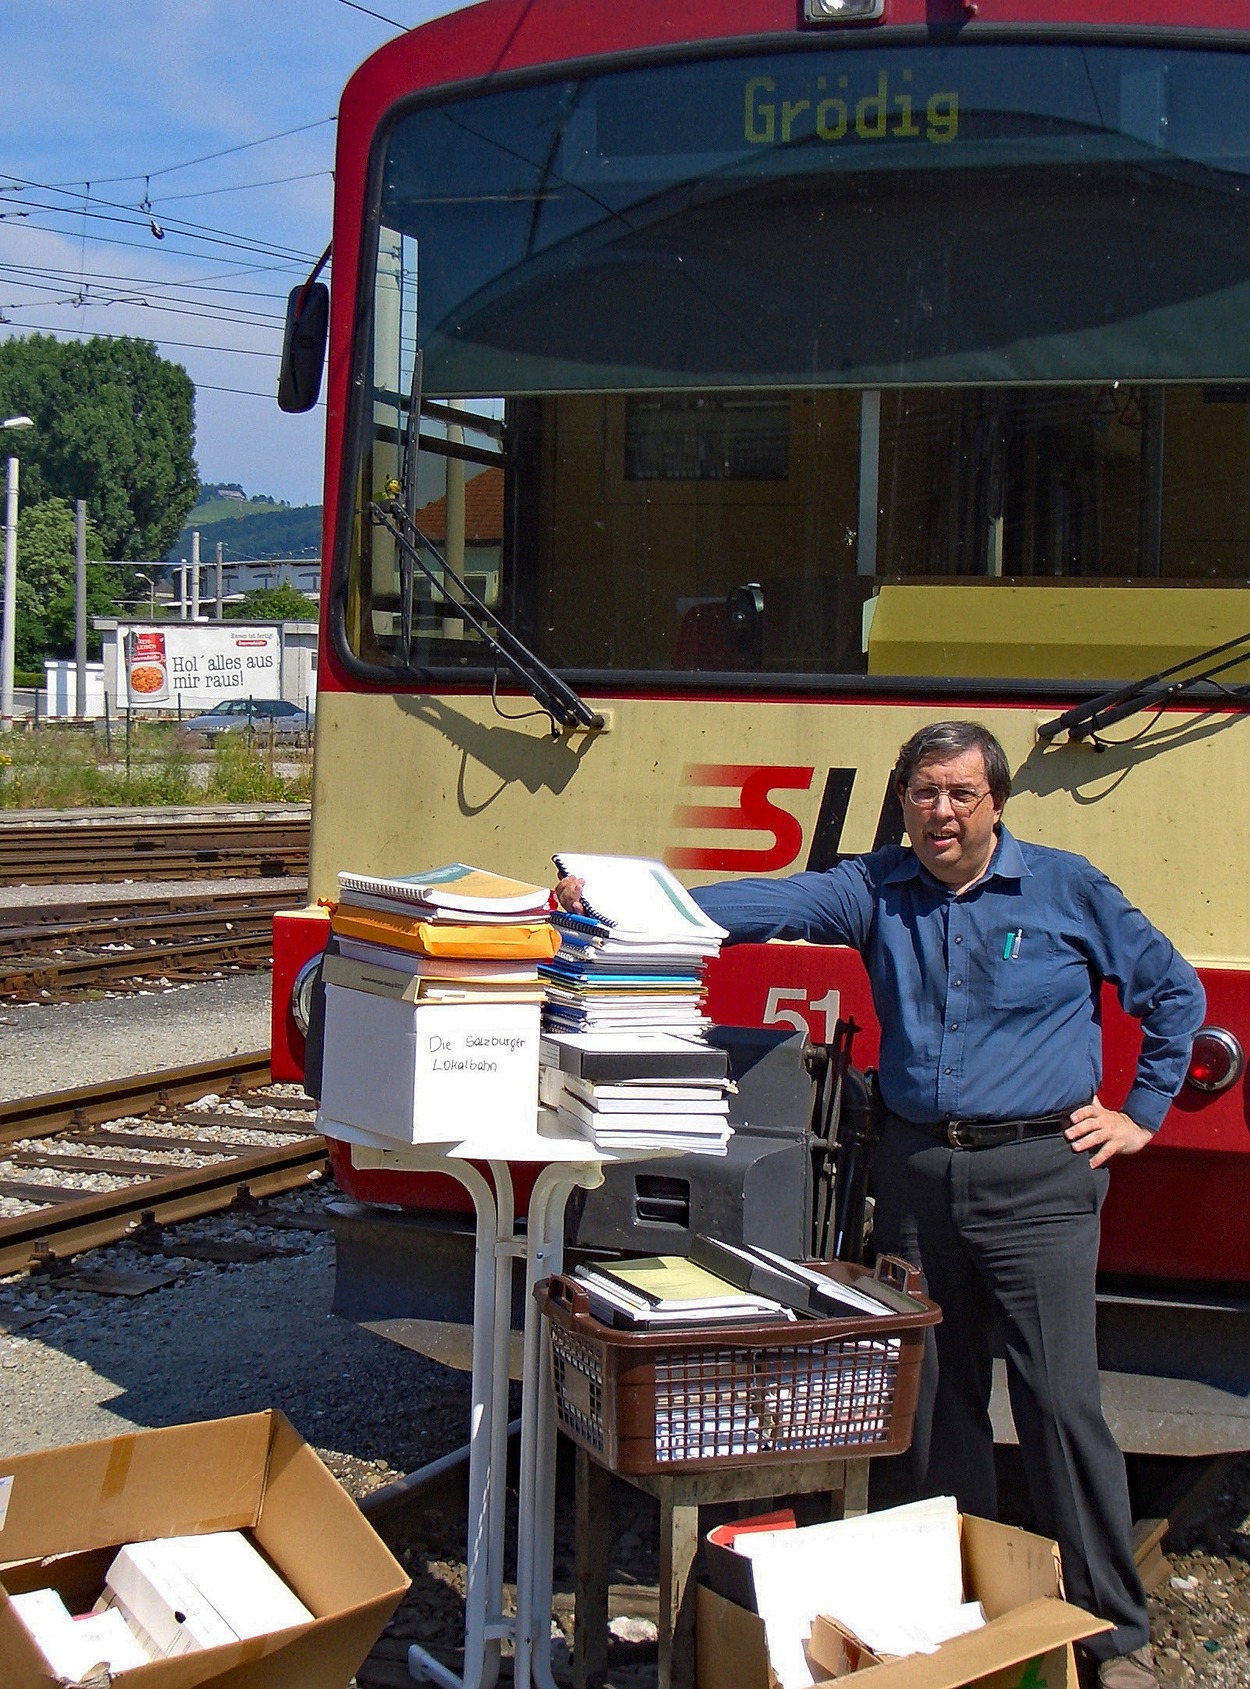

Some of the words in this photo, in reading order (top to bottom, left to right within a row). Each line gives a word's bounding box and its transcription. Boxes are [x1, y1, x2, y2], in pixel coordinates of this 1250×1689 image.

[744, 68, 959, 144] Grödig
[207, 654, 242, 671] alles
[246, 655, 273, 669] aus
[173, 673, 201, 689] mir
[205, 670, 244, 688] raus!
[762, 987, 840, 1045] 51
[429, 1035, 453, 1053] Die
